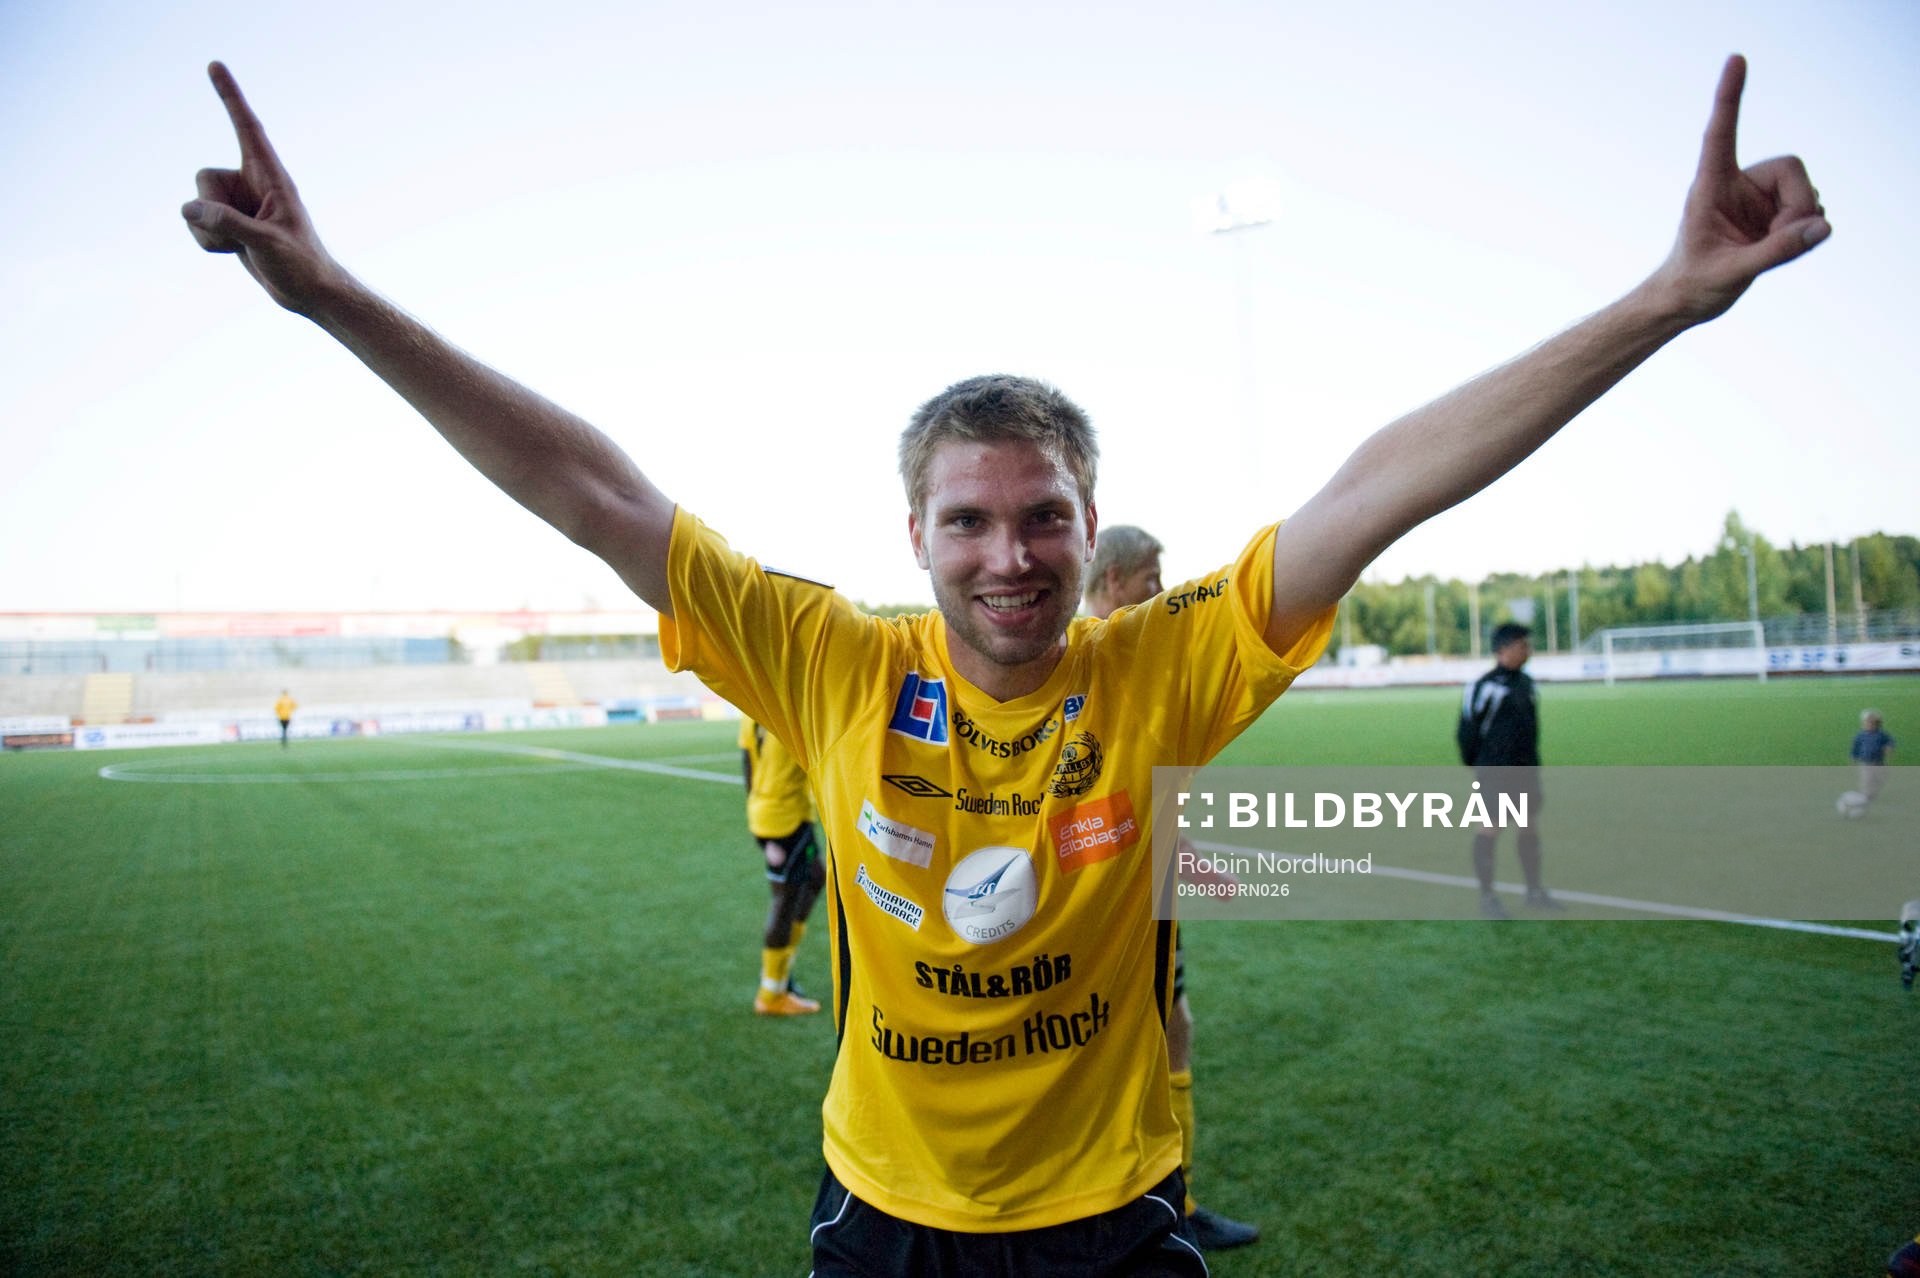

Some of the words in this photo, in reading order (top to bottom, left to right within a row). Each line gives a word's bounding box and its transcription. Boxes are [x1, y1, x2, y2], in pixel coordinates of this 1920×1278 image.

[952, 712, 1059, 758] SÖLVESBORG
[955, 788, 1009, 816] Sweden
[876, 820, 913, 843] Karlshamns
[914, 835, 933, 849] Hamn
[860, 866, 922, 917] SNDINAVIAN
[875, 896, 920, 927] STORAGE
[965, 919, 1016, 939] CREDITS
[914, 953, 1072, 999] STÅL&RÖR
[871, 1005, 1016, 1065] Sweden
